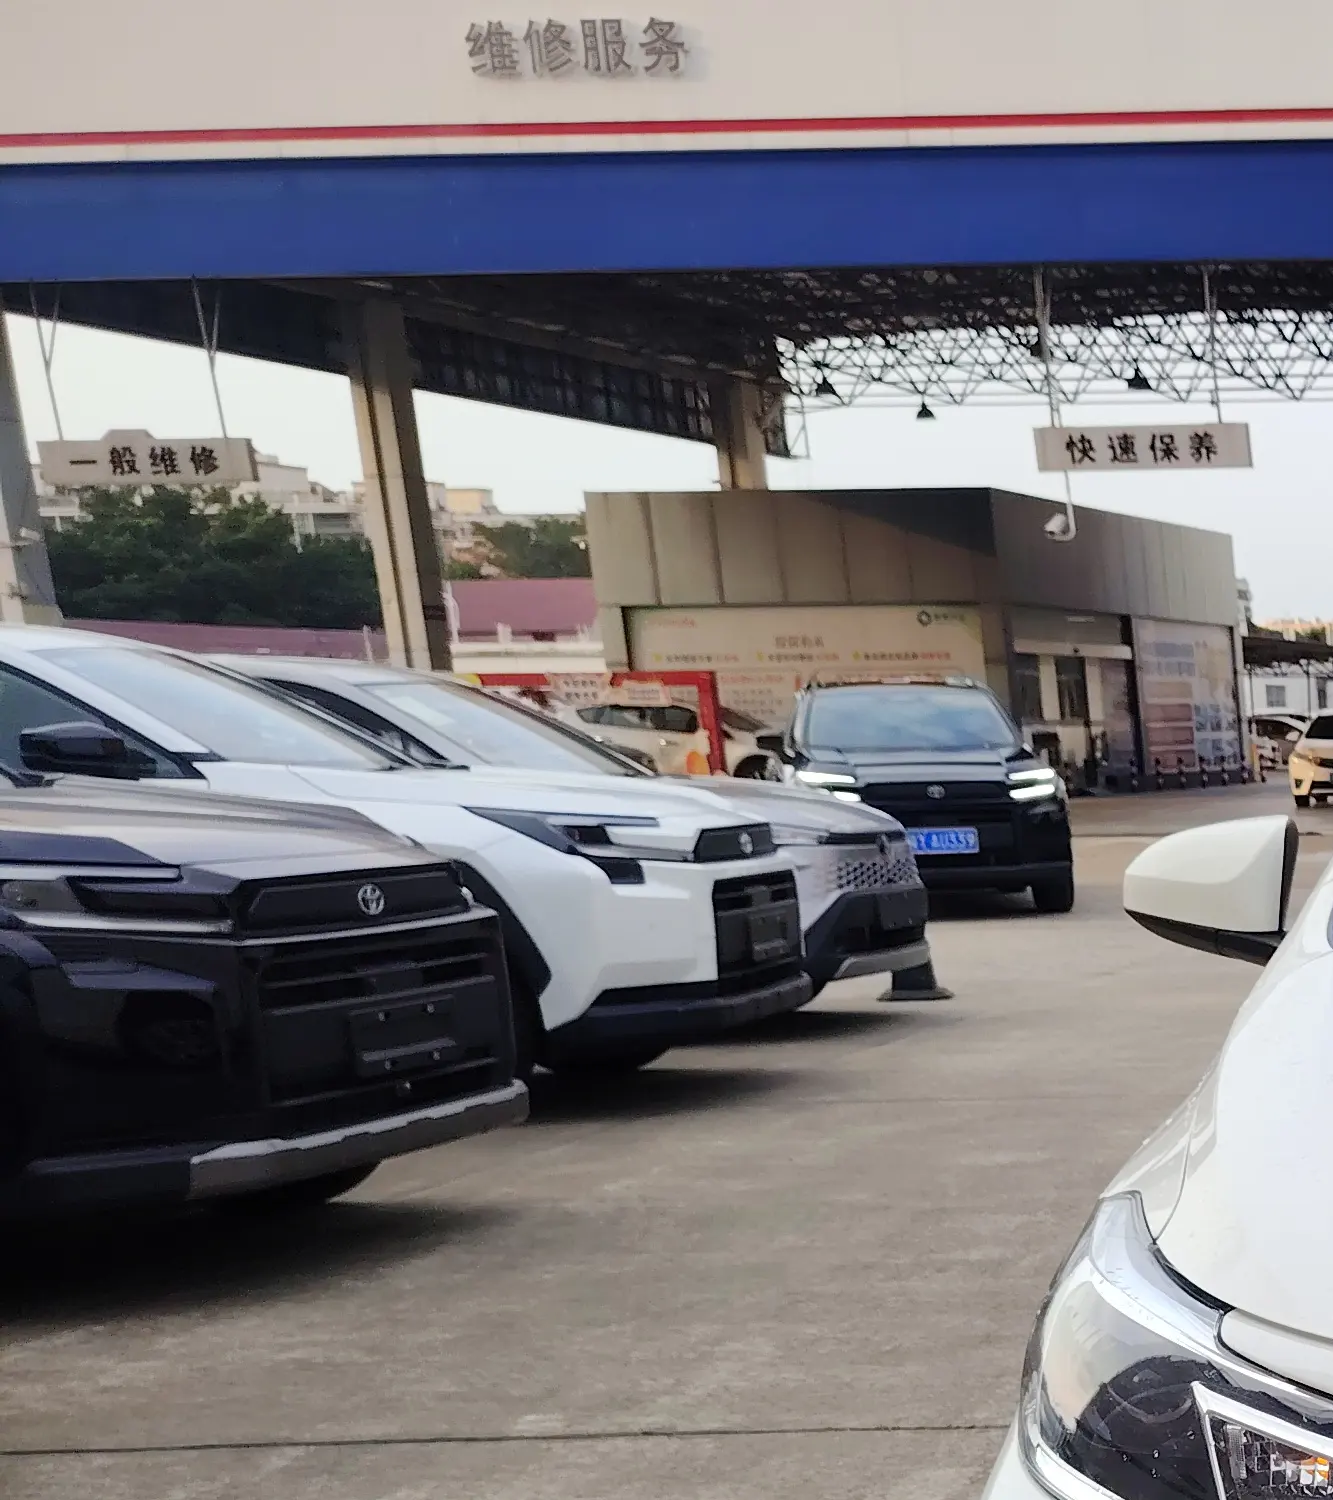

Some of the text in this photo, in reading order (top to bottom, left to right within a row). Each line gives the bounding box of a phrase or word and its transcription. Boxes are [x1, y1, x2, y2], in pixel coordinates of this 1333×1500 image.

[464, 16, 690, 75] 维修服务
[68, 445, 220, 476] 一般维修
[1065, 431, 1218, 465] 快速保养
